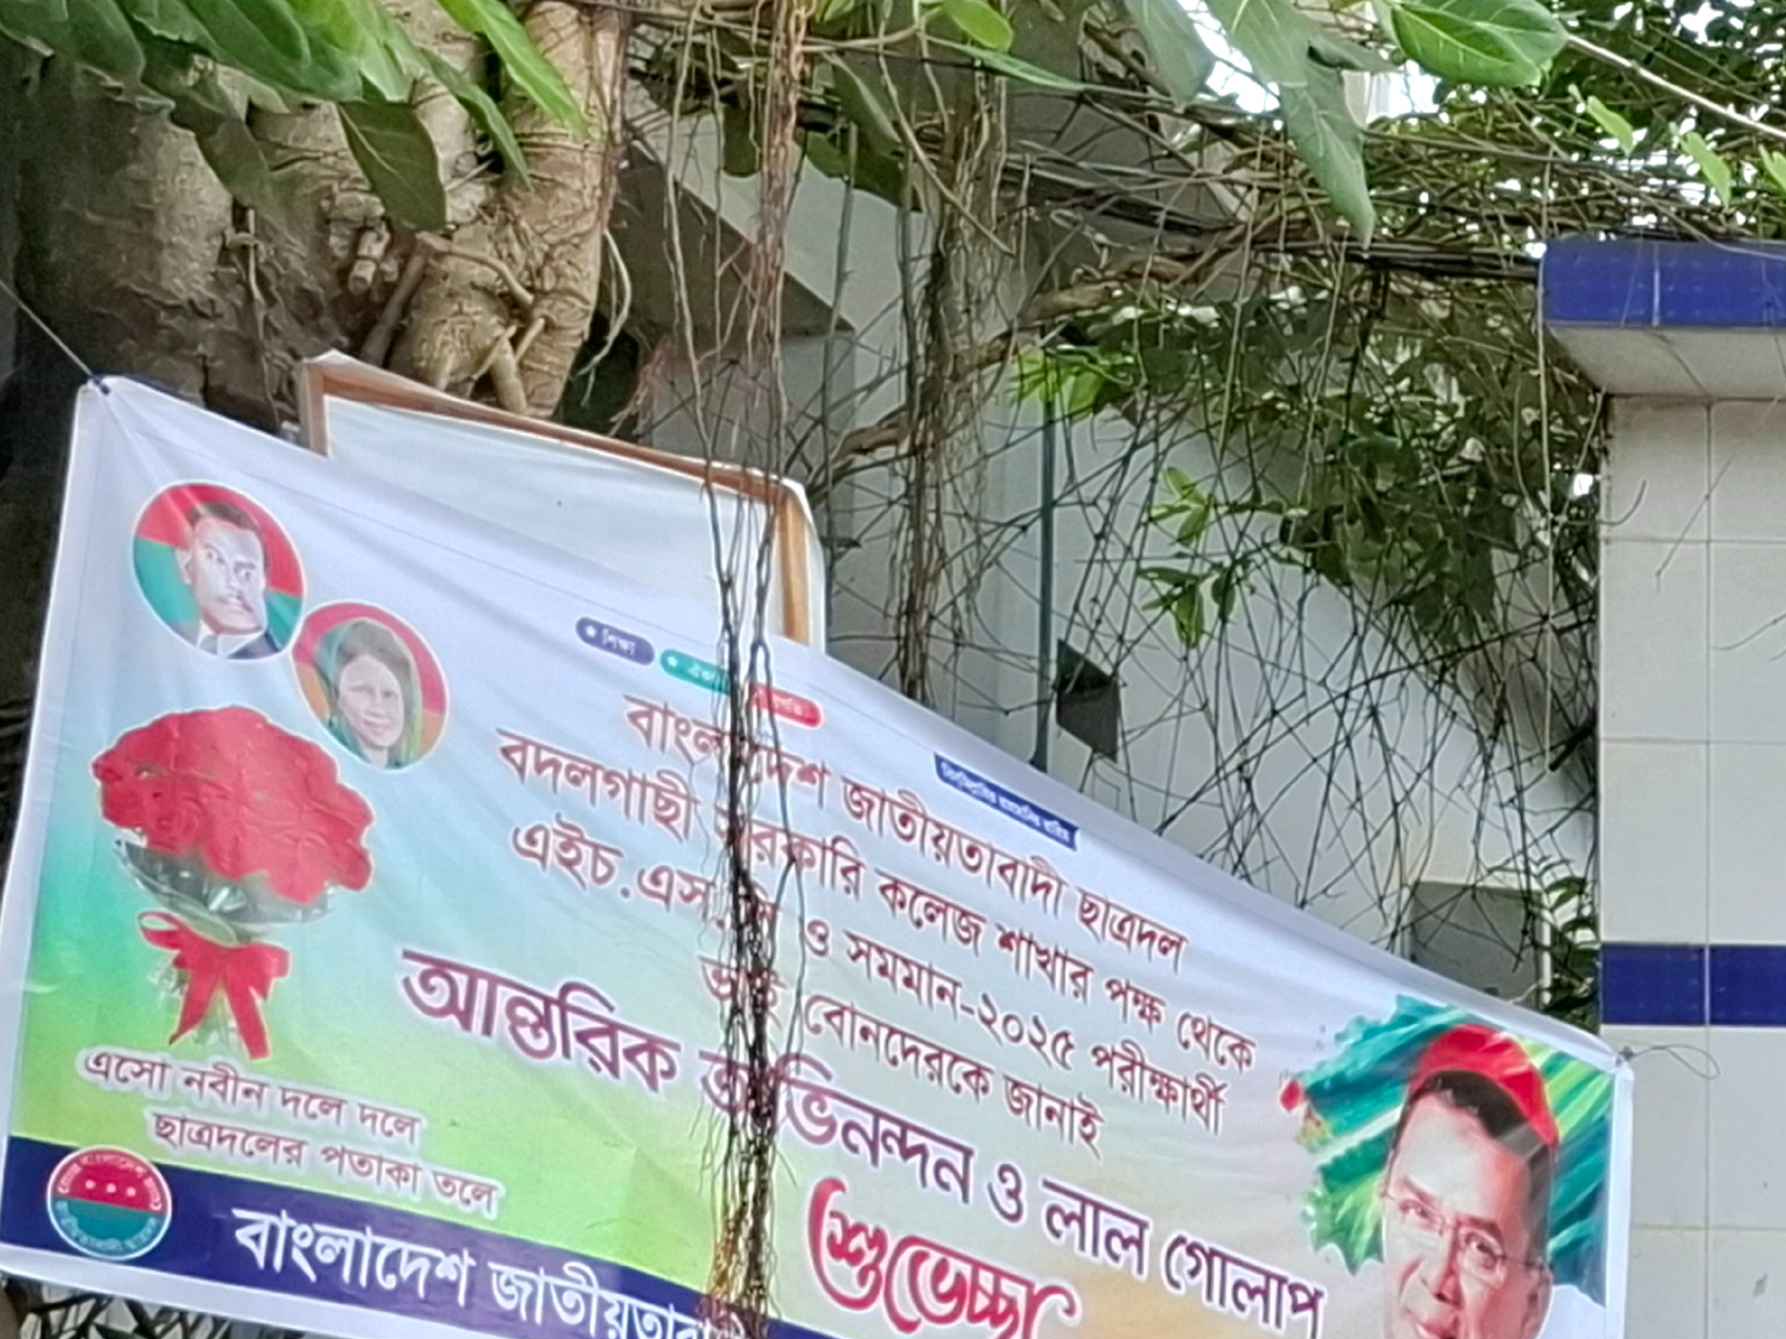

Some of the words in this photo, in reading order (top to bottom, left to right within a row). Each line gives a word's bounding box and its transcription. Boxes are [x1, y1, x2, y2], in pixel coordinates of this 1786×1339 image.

[496, 729, 700, 842] বদলগাছী
[877, 865, 988, 954] কলেজ
[997, 921, 1093, 1010] শাখার
[1107, 973, 1166, 1049] পক্ষ
[1177, 1004, 1257, 1075] থেকে
[841, 778, 1070, 914] জাতীয়তাবাদী
[1077, 878, 1188, 975] ছাত্রদল
[83, 1046, 172, 1100] এসো
[183, 1060, 269, 1117] নবীন
[280, 1079, 347, 1126] দলে
[357, 1099, 423, 1146] দলে
[401, 949, 684, 1093] আন্তরিক
[988, 1160, 1028, 1224] ও
[1041, 1175, 1151, 1282] লাল
[804, 993, 995, 1105] বোনদেরকে
[1006, 1064, 1105, 1160] জানাই
[806, 920, 830, 956] ও
[845, 930, 1077, 1073] সমমান-২০২৫
[1090, 1038, 1231, 1138] পরীক্ষার্থী
[151, 1108, 307, 1167] ছাত্রদলের
[320, 1139, 424, 1197] পতাকা
[432, 1169, 504, 1216] তলে
[231, 1204, 478, 1309] বাংলাদেশ
